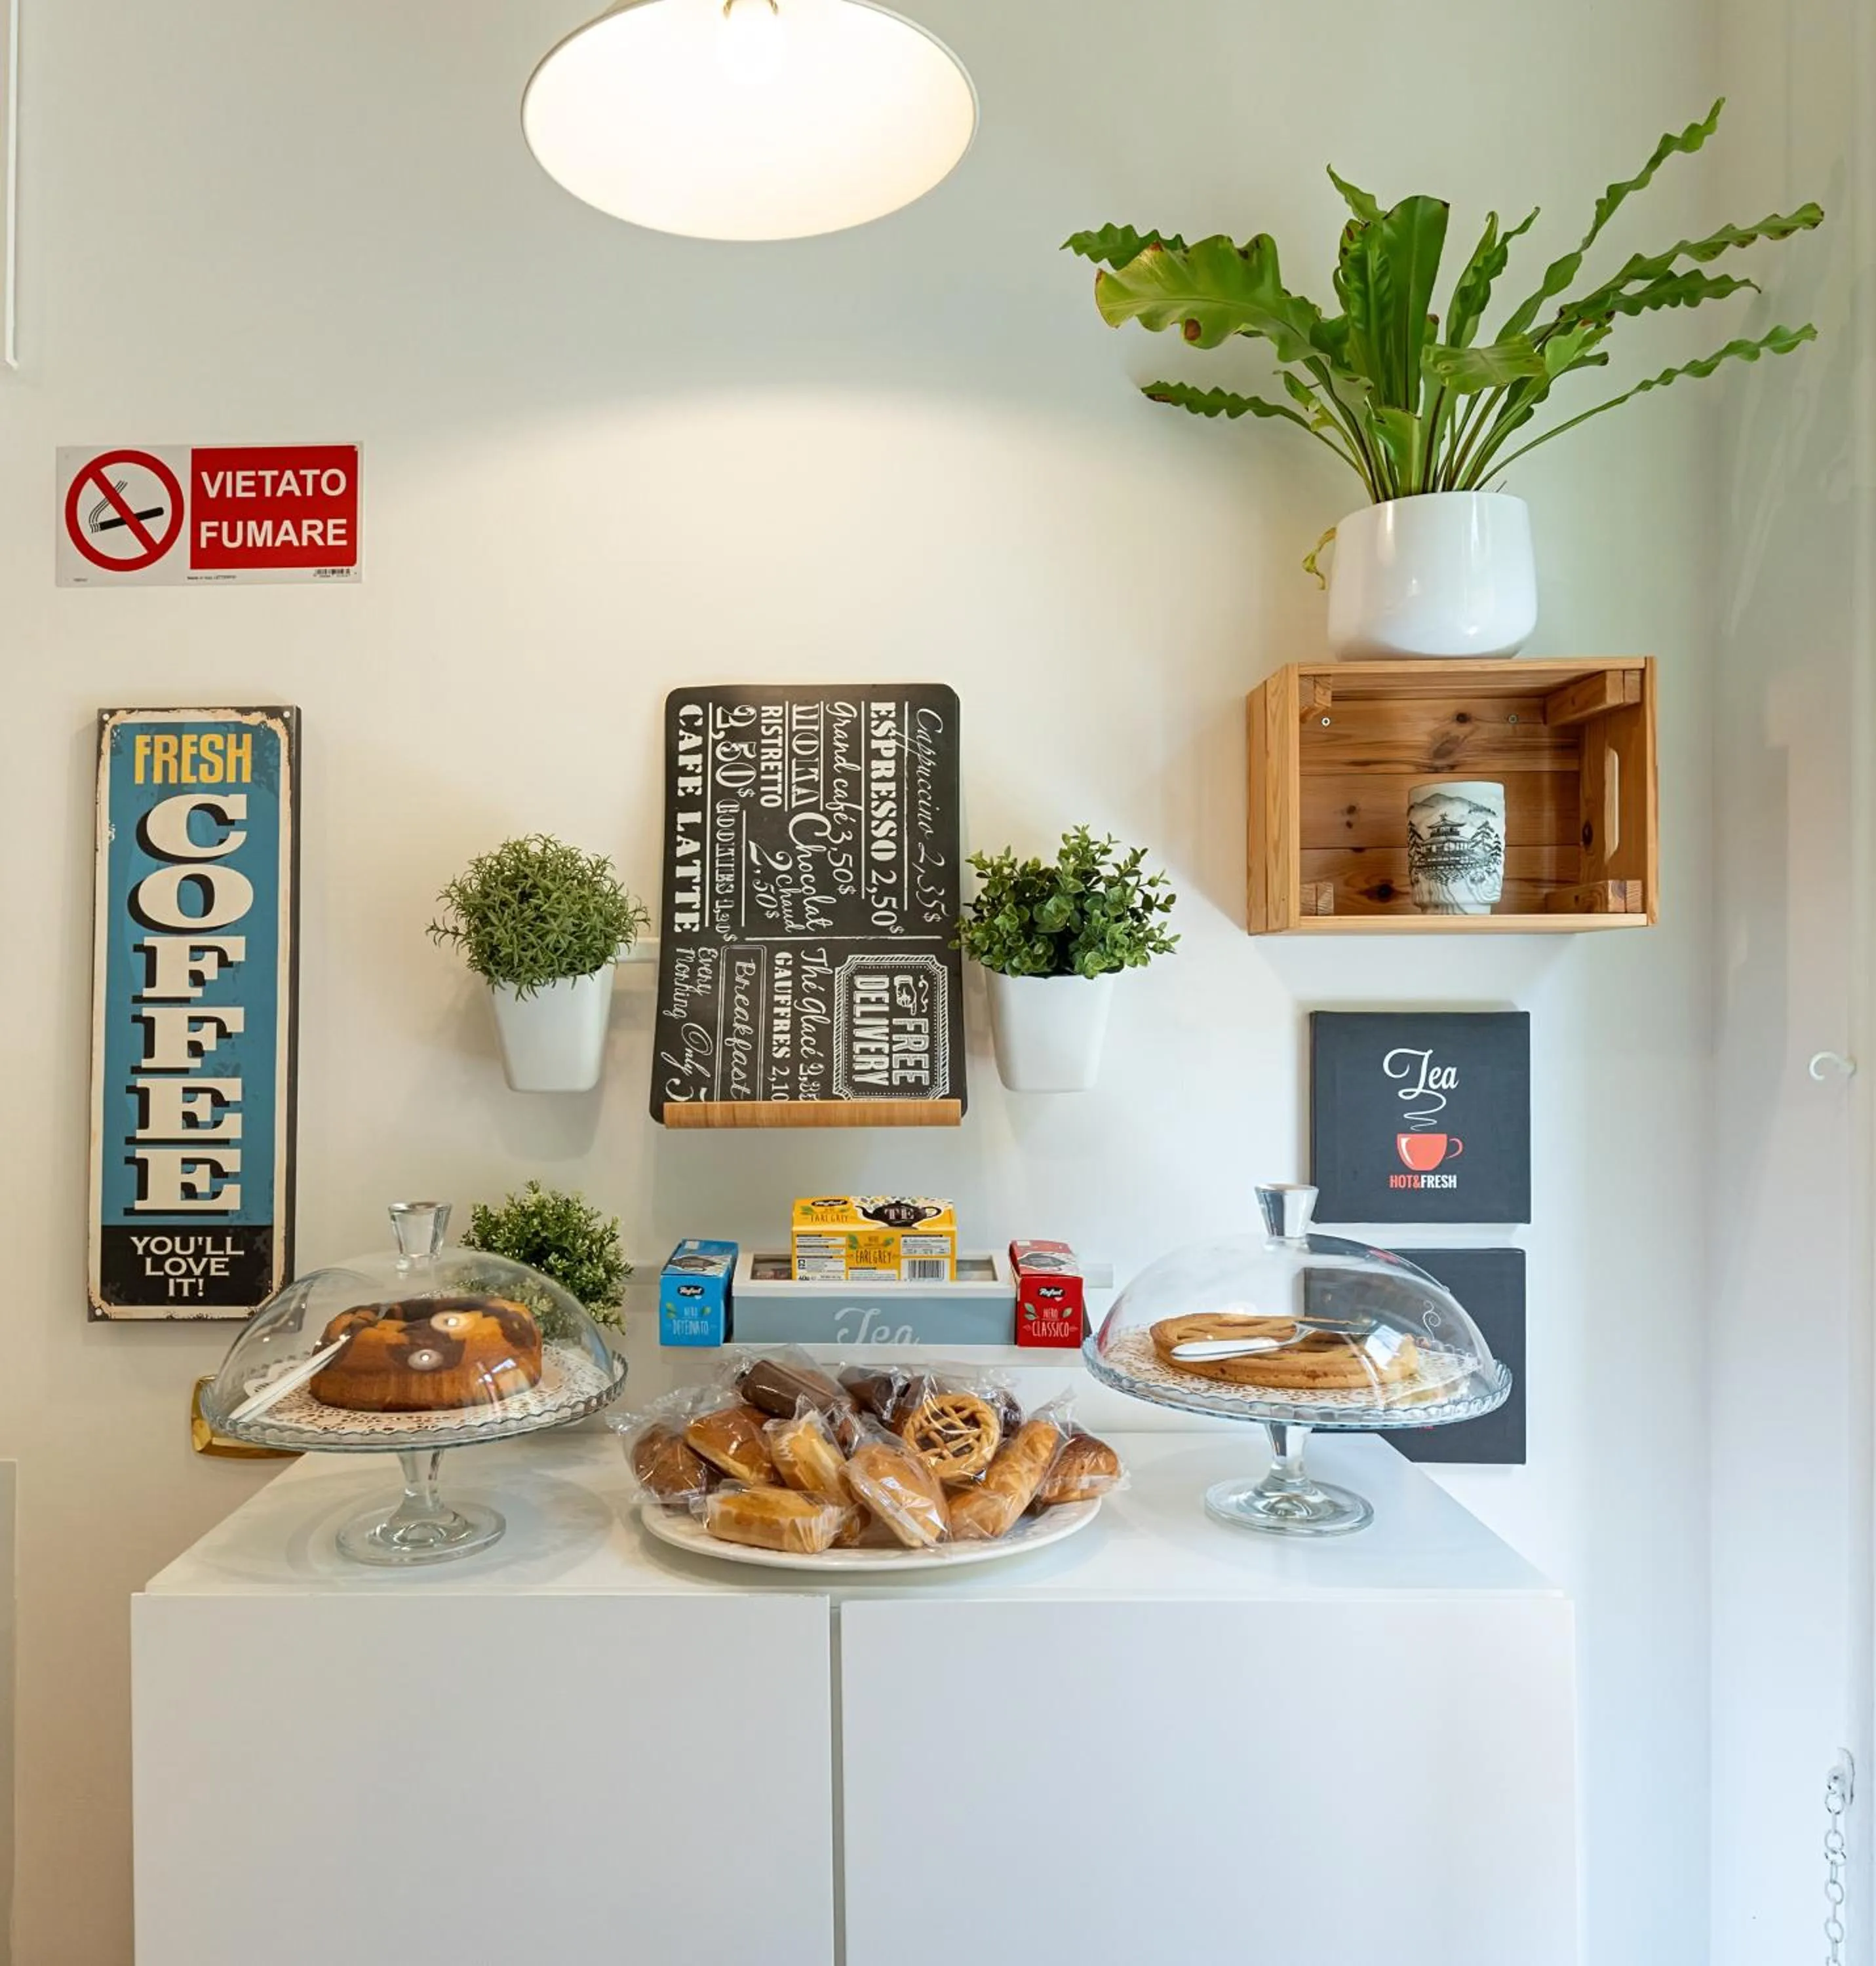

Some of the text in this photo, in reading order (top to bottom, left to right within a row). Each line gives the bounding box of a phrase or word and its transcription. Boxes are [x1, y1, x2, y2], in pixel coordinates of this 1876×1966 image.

[201, 469, 347, 498] VIETATO
[200, 518, 347, 549] FUMARE
[134, 733, 252, 784] FRESH
[760, 705, 783, 808] RISTRETTO
[791, 704, 820, 809] MOKA
[870, 702, 897, 862] ESPRESSO
[889, 708, 943, 838] Cappuccino
[673, 704, 703, 933] CAFE LATTE
[789, 812, 836, 931] Chocolat
[663, 948, 697, 1020] Morning
[695, 946, 718, 997] Every
[800, 948, 832, 993] Thé
[127, 794, 254, 1216] COFFEE
[724, 957, 756, 1101] Breakfast
[772, 952, 792, 1058] GAUFFRES
[853, 974, 890, 1087] DELIVERY
[661, 1022, 713, 1081] Only
[892, 1018, 930, 1087] FREE
[1382, 1049, 1460, 1100] Tea
[1389, 1174, 1458, 1188] HOT&FRESH
[130, 1237, 244, 1255] YOU'LL
[146, 1258, 229, 1276] LOVE
[168, 1278, 205, 1297] IT!
[1032, 1321, 1069, 1337] CLASSICO
